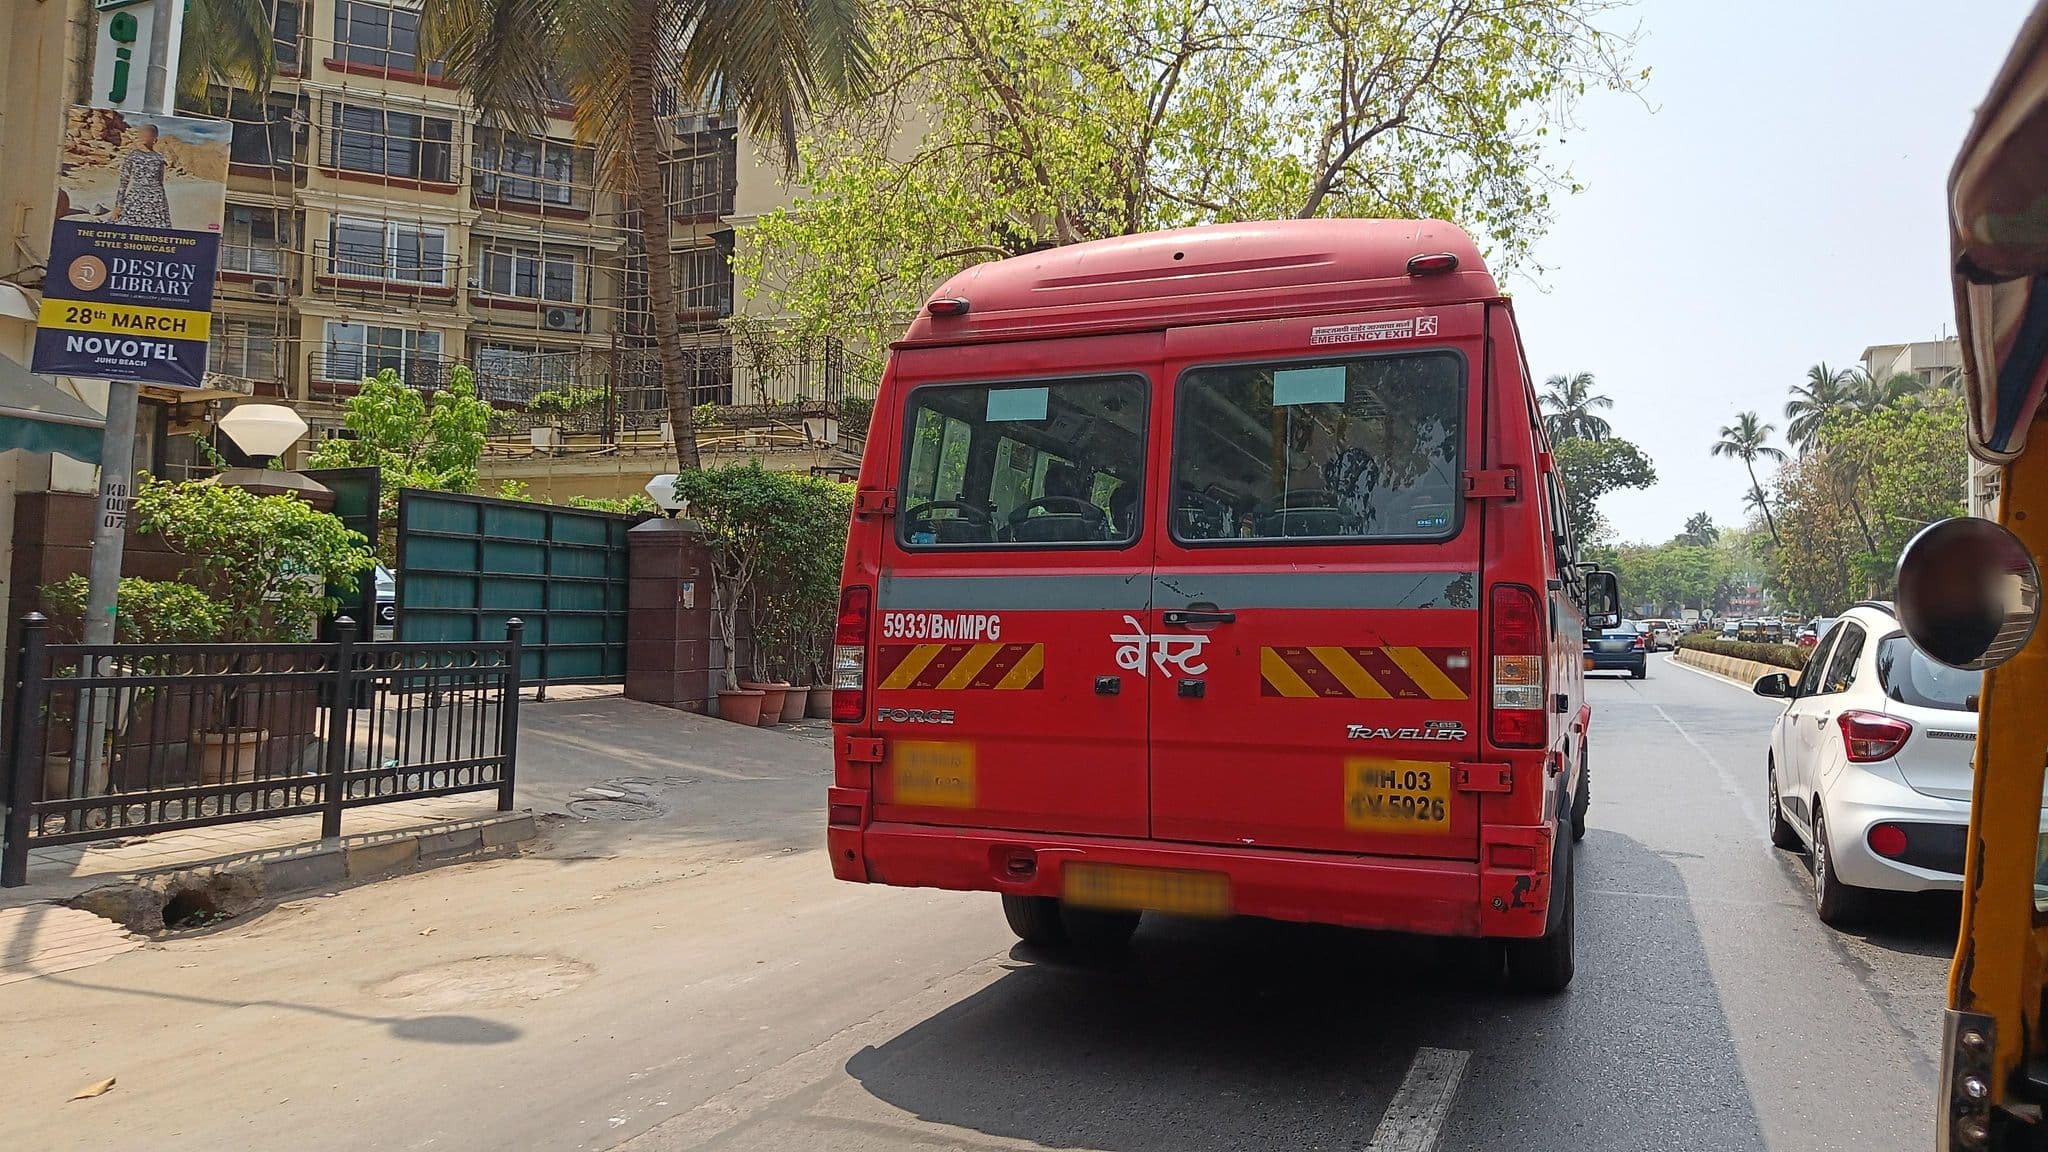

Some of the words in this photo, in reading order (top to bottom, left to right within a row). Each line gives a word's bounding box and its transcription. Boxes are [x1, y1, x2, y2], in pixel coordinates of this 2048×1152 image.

[77, 229, 95, 238] THE
[96, 230, 127, 240] CITY'S
[129, 233, 197, 246] TRENDSETTING
[94, 240, 121, 249] STYLE
[123, 242, 177, 254] SHOWCASE
[111, 257, 197, 281] DESIGN
[109, 275, 194, 297] LIBRARY
[65, 306, 107, 325] 28th
[111, 312, 187, 333] MARCH
[1311, 332, 1381, 344] EMERGENCY
[1385, 329, 1411, 339] EXIT
[66, 335, 178, 361] NOVOTEL
[94, 356, 117, 364] JUHU
[118, 358, 147, 367] BEACH
[1109, 614, 1211, 679] बेस्ट
[877, 707, 955, 724] FORCE
[1361, 769, 1432, 791] H.03
